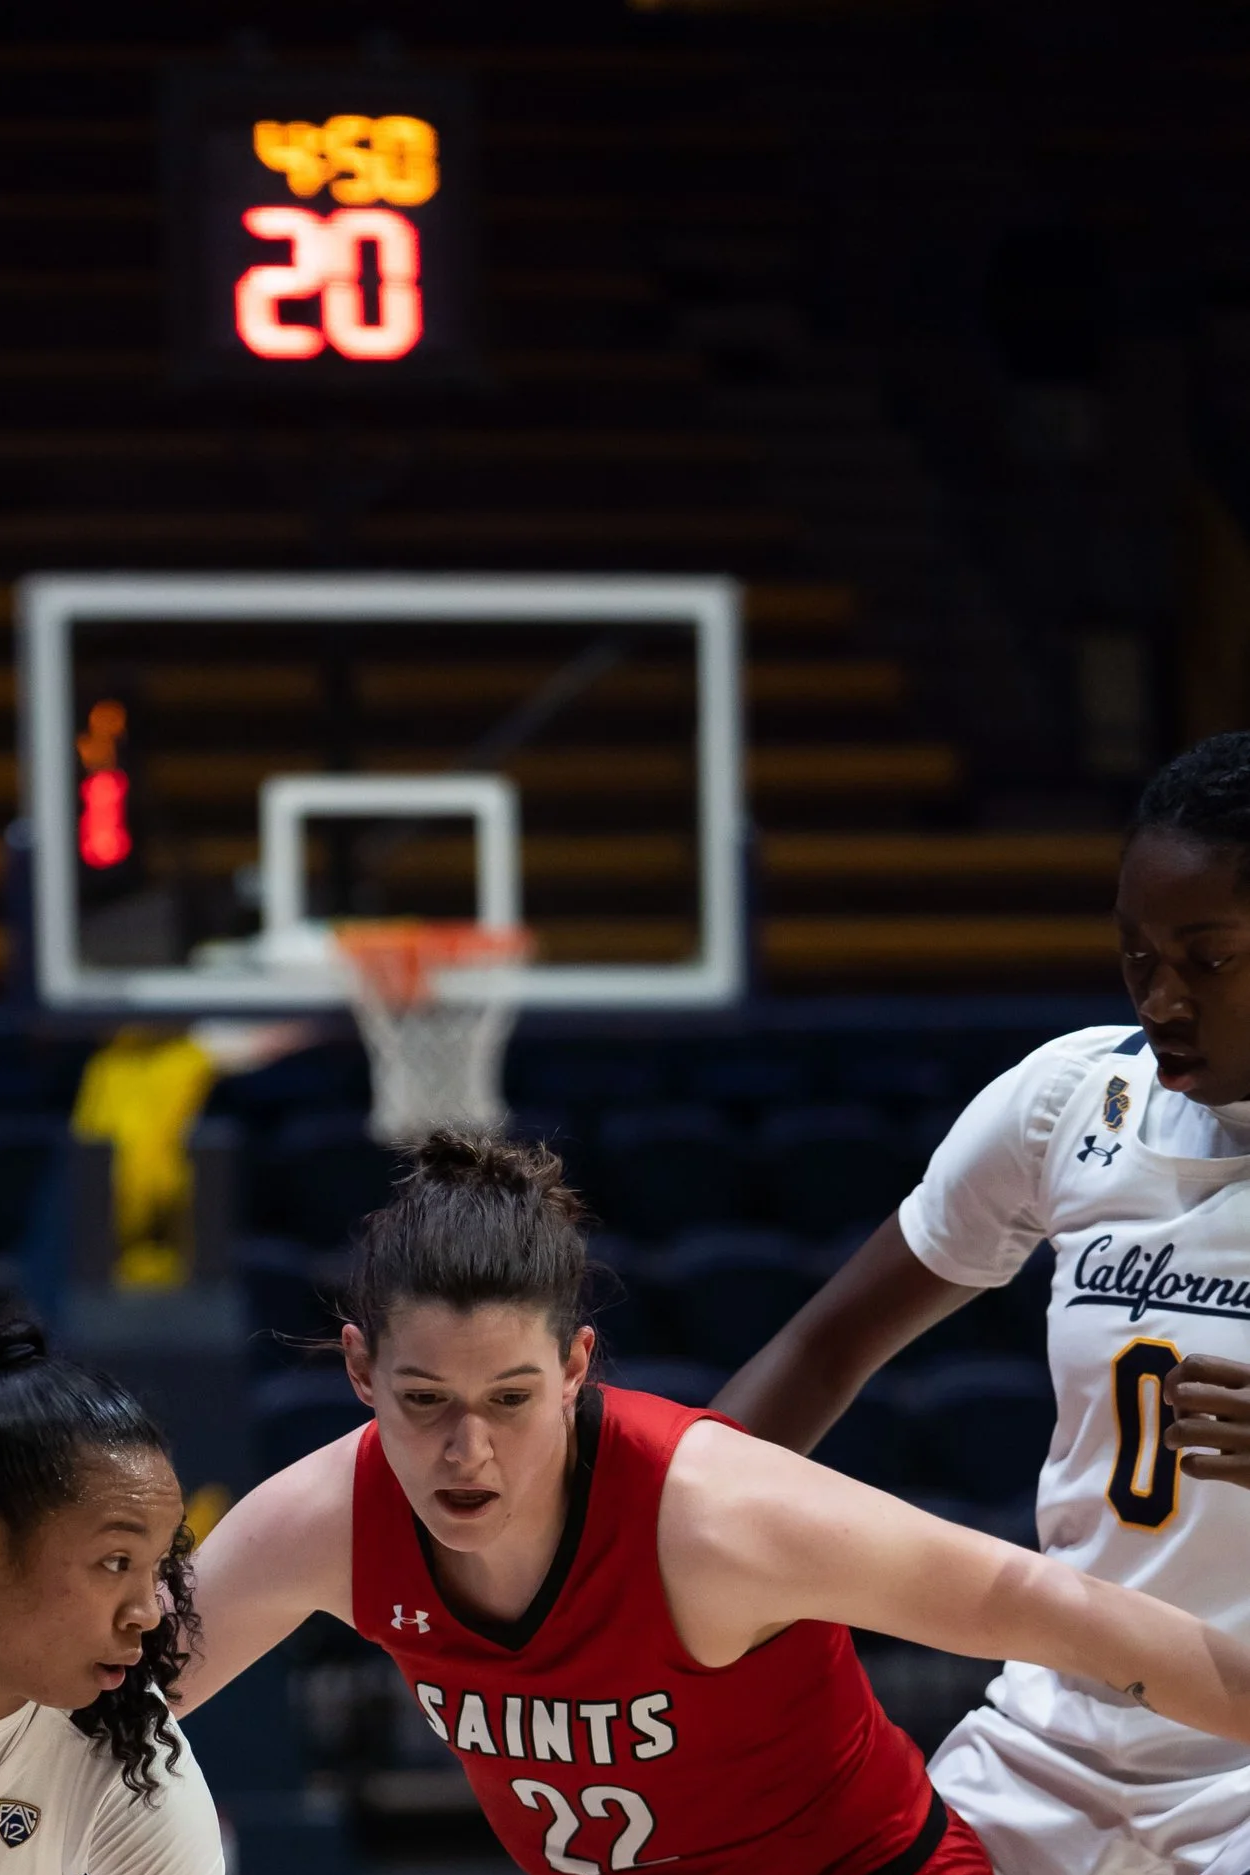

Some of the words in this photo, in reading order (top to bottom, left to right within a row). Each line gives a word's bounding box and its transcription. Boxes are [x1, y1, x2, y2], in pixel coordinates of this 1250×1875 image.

[235, 206, 424, 361] 20
[1070, 1234, 1250, 1323] Californi
[1104, 1336, 1184, 1535] 0
[415, 1682, 676, 1766] SAINTS
[3, 1821, 25, 1841] 12
